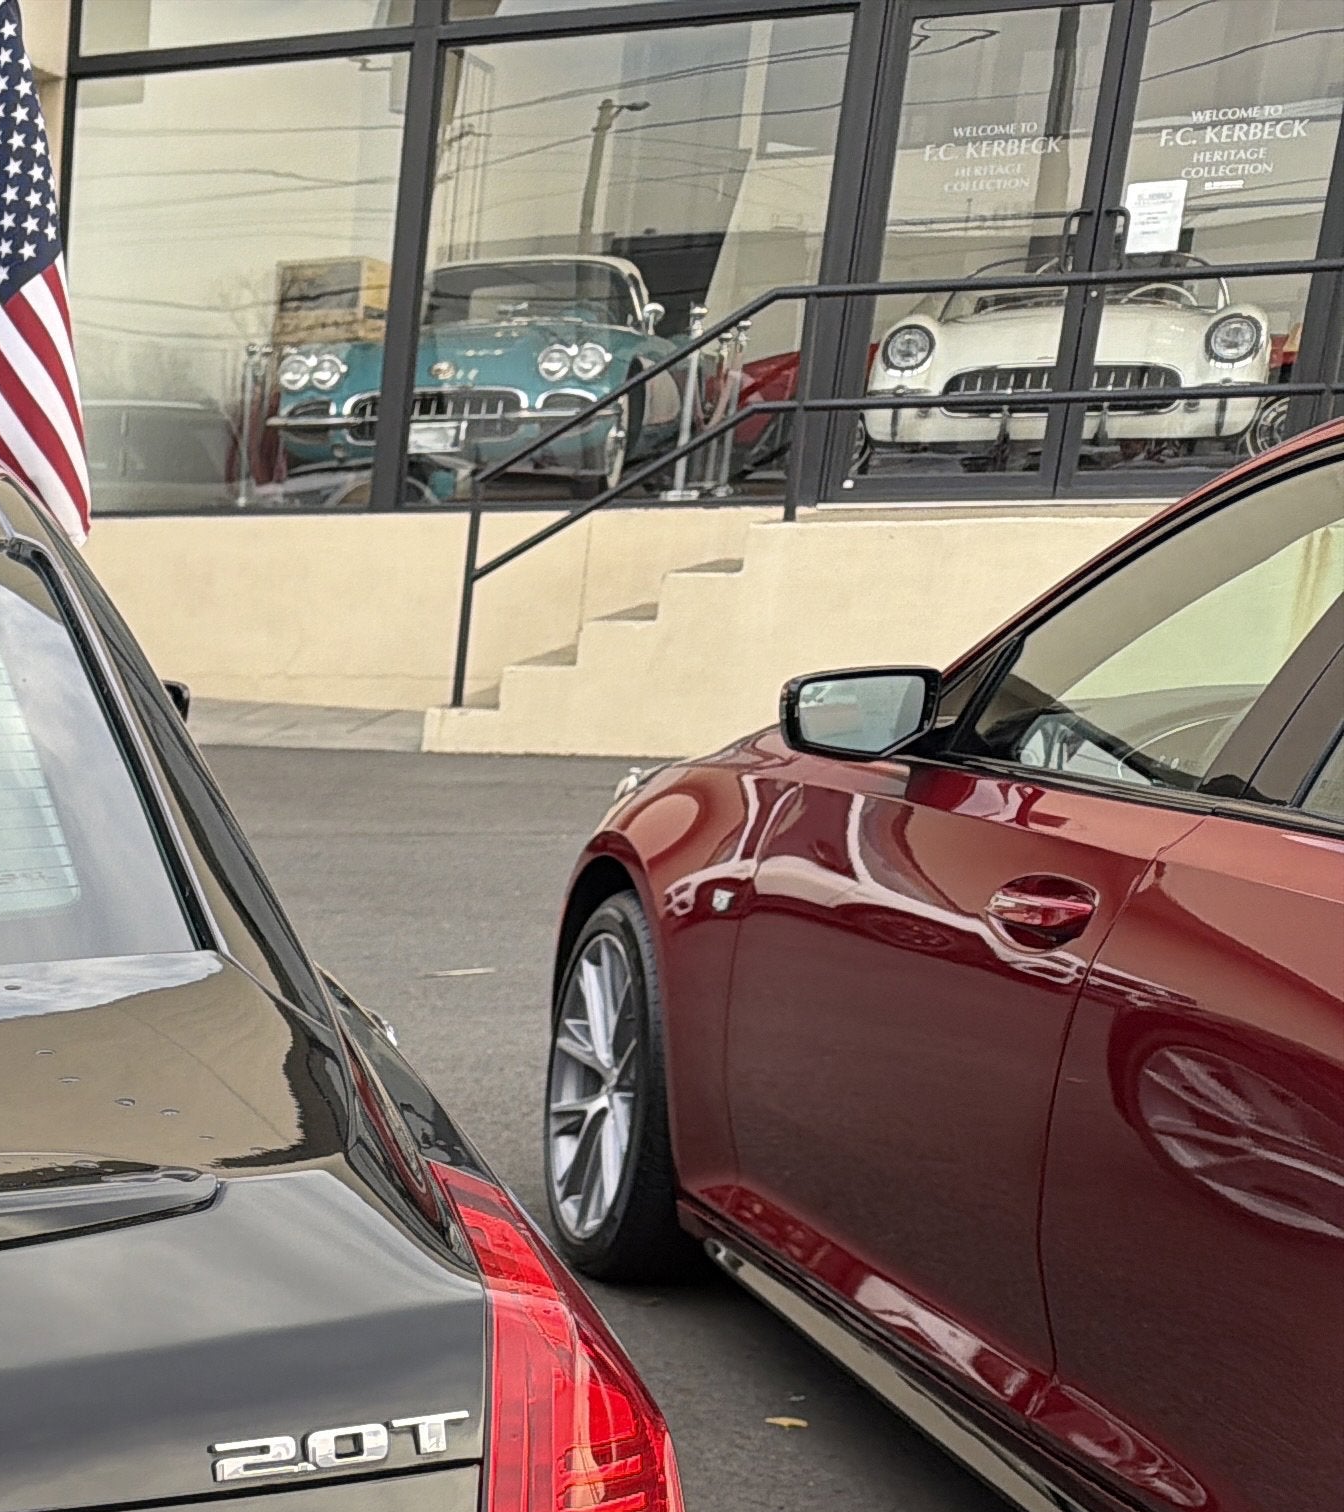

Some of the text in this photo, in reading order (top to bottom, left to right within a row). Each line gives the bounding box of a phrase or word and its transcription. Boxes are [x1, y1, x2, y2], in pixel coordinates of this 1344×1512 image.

[1192, 105, 1283, 122] WELCOME TO
[953, 122, 1037, 137] WELCOME TO
[1160, 119, 1310, 147] F.C. KERBECK
[966, 135, 1063, 159] KERBECK
[1193, 147, 1267, 163] HERITAGE
[955, 163, 1023, 178] HERITAGE
[1181, 162, 1273, 179] COLLECTION
[944, 178, 1030, 193] COLLECTION
[208, 1410, 469, 1482] 2.0T
